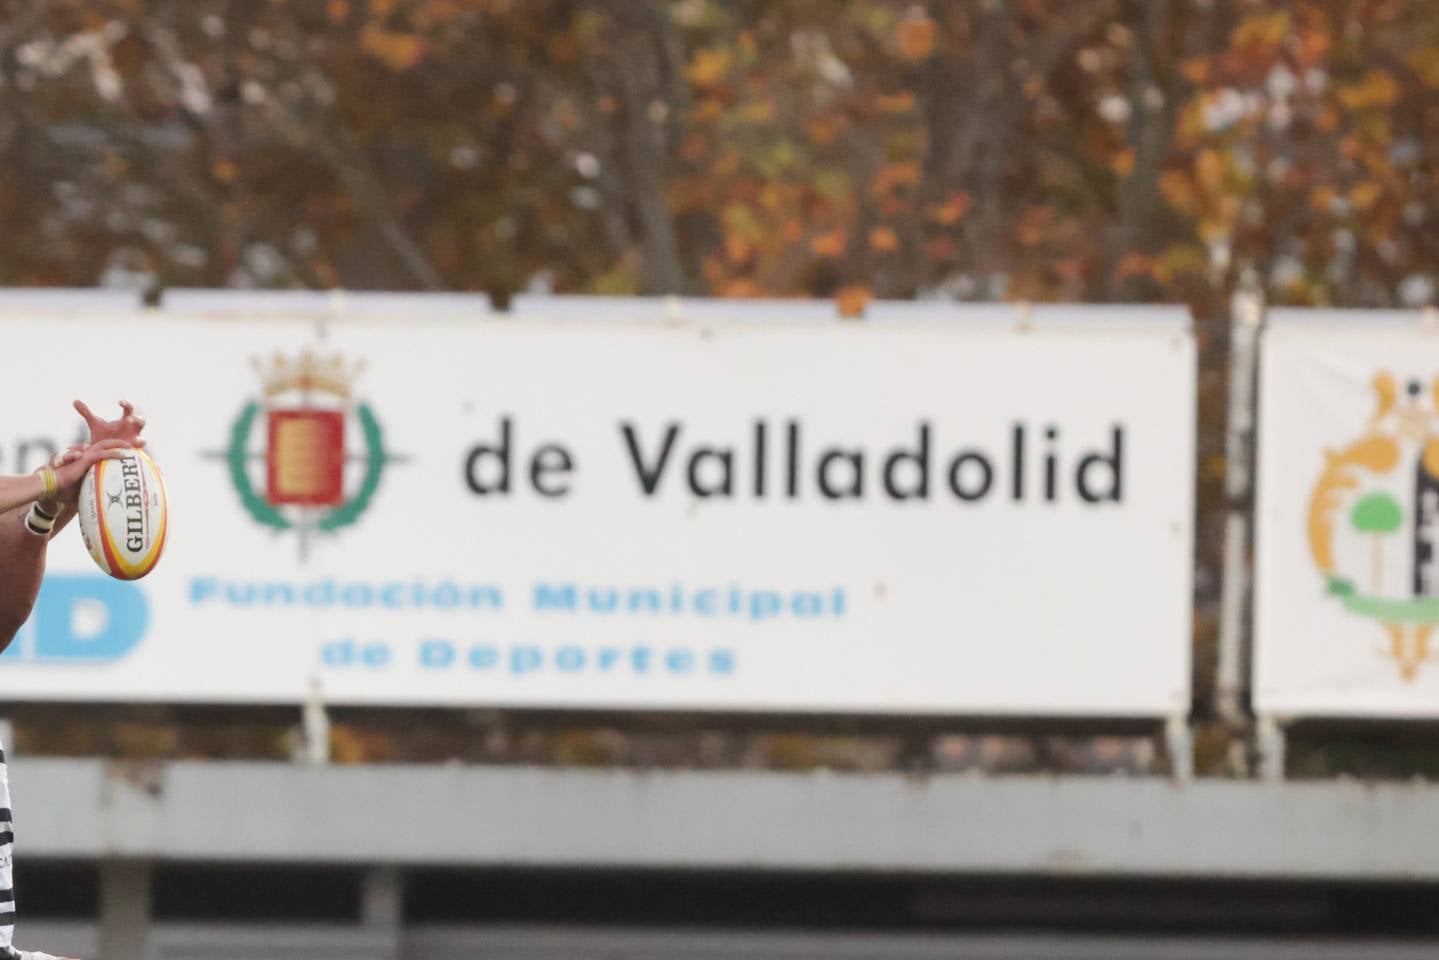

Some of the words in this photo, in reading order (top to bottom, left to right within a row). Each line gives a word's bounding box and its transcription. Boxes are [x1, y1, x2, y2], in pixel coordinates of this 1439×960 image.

[464, 418, 574, 497] de
[623, 421, 1124, 503] Valladolid
[121, 455, 144, 553] GILBERT
[187, 578, 502, 610] Fundación
[533, 582, 846, 619] Municipal
[321, 638, 390, 668] de
[419, 640, 736, 674] Deportes
